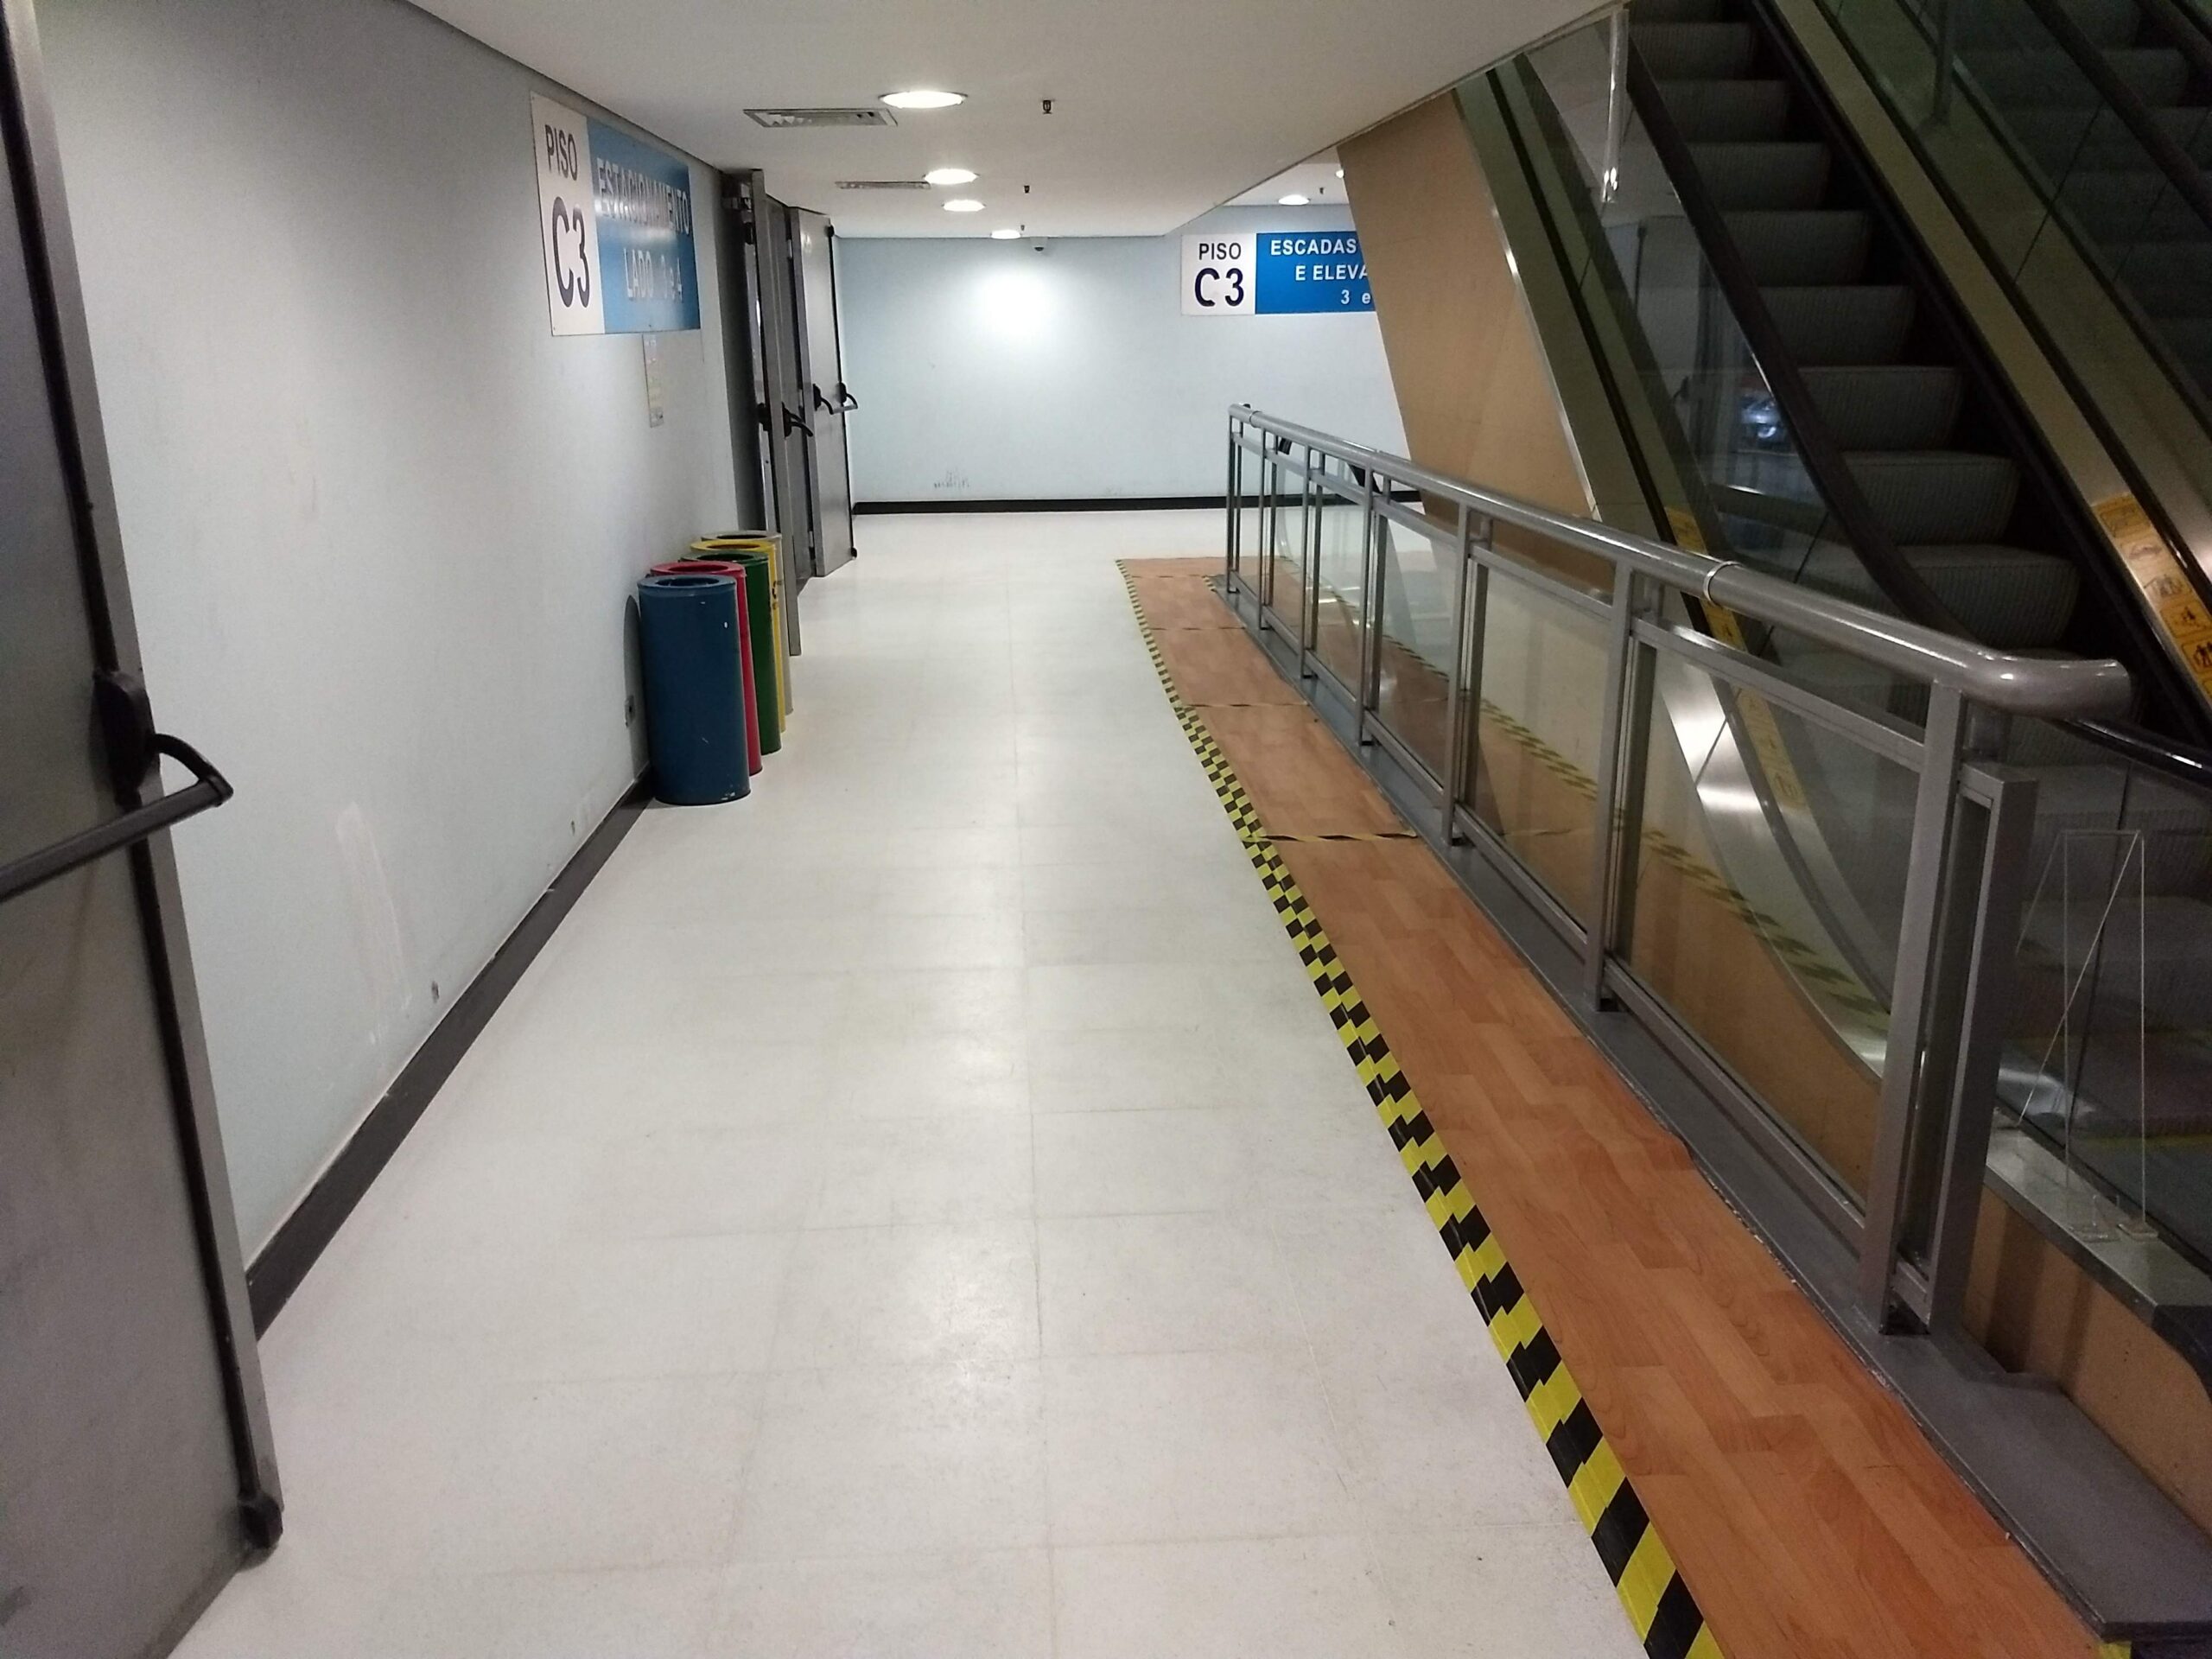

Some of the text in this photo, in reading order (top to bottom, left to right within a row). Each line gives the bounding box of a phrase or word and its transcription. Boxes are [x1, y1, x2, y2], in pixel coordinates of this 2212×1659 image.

[544, 124, 578, 181] PISO
[596, 157, 690, 236] ESTACIONAMENTO
[552, 196, 590, 308] C3
[1198, 242, 1242, 260] PISO
[1270, 238, 1357, 256] ESCADAS
[624, 247, 653, 299] LADO
[1194, 267, 1244, 307] C3
[1294, 264, 1306, 281] E
[1340, 289, 1371, 305] 3 e
